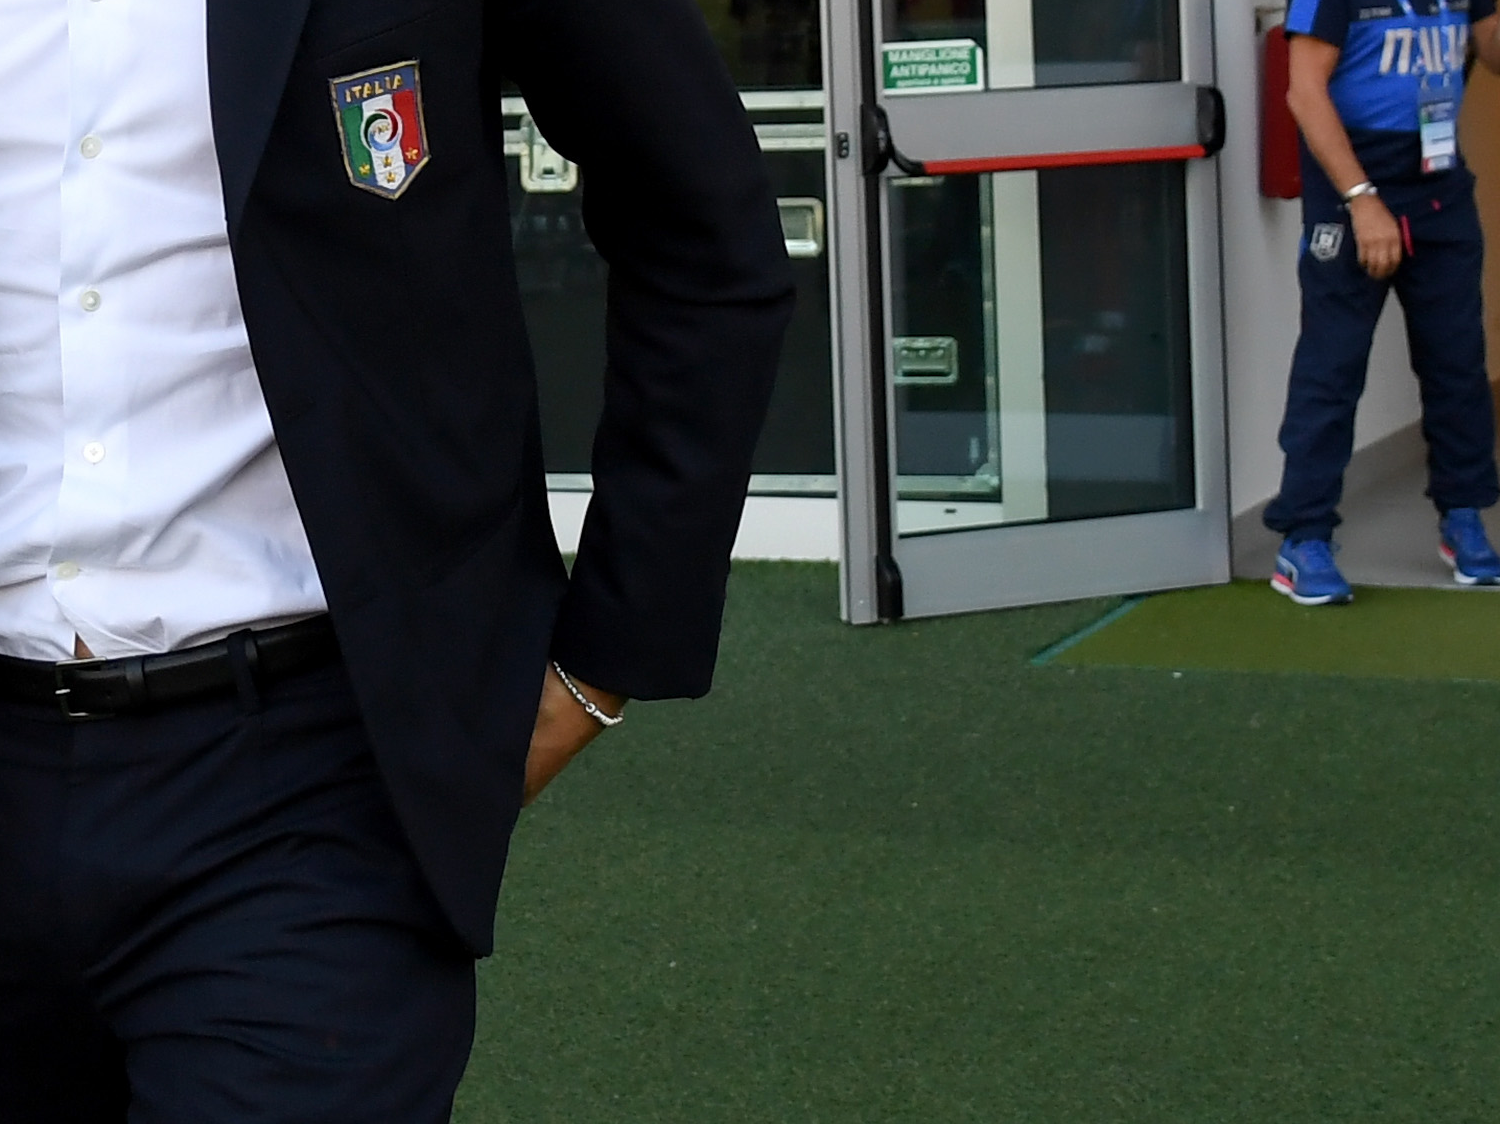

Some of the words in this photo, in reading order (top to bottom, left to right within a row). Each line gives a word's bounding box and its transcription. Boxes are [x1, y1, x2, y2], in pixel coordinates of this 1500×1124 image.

[888, 47, 971, 63] MANIGLIONE
[890, 61, 971, 78] ANTIPANICO
[345, 74, 404, 102] ITALIA
